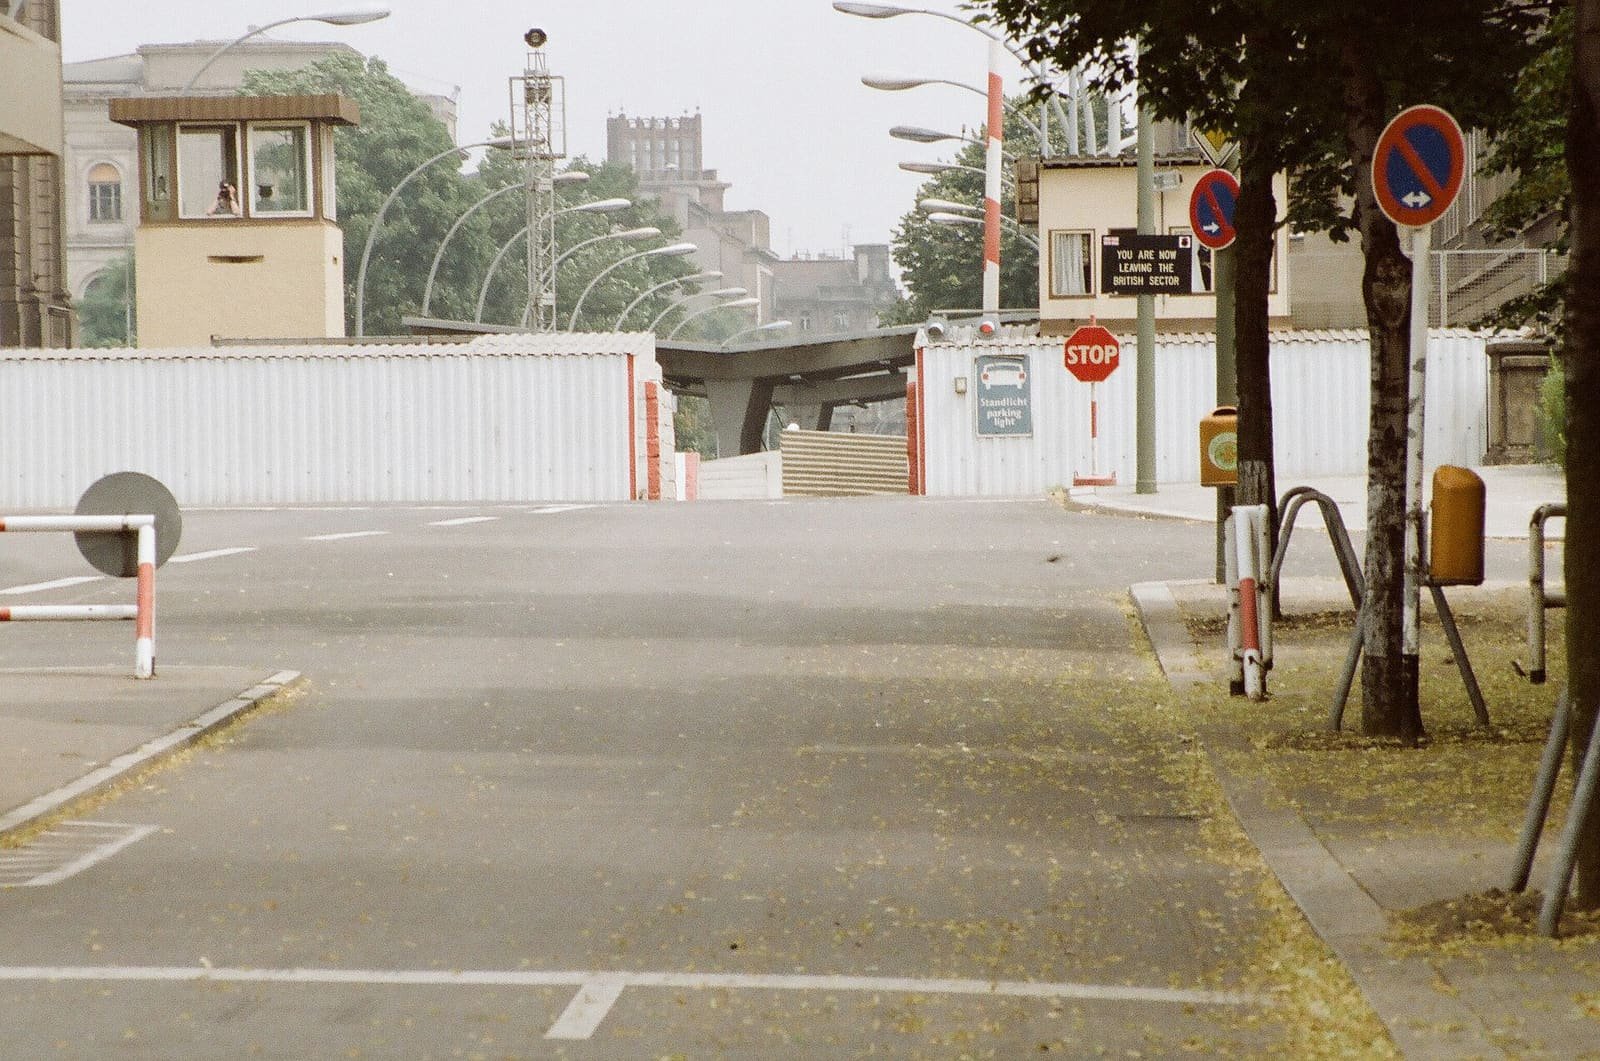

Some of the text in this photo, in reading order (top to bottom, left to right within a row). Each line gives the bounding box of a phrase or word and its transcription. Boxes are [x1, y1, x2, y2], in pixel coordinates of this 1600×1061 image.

[1117, 250, 1177, 260] YOU ARE NOW
[1119, 263, 1174, 273] LEAVING THE
[1113, 276, 1179, 286] BRITISH SECTOR
[1067, 345, 1118, 365] STOP
[980, 397, 1028, 407] Standlicht
[987, 407, 1022, 420] parking
[994, 417, 1015, 429] light
